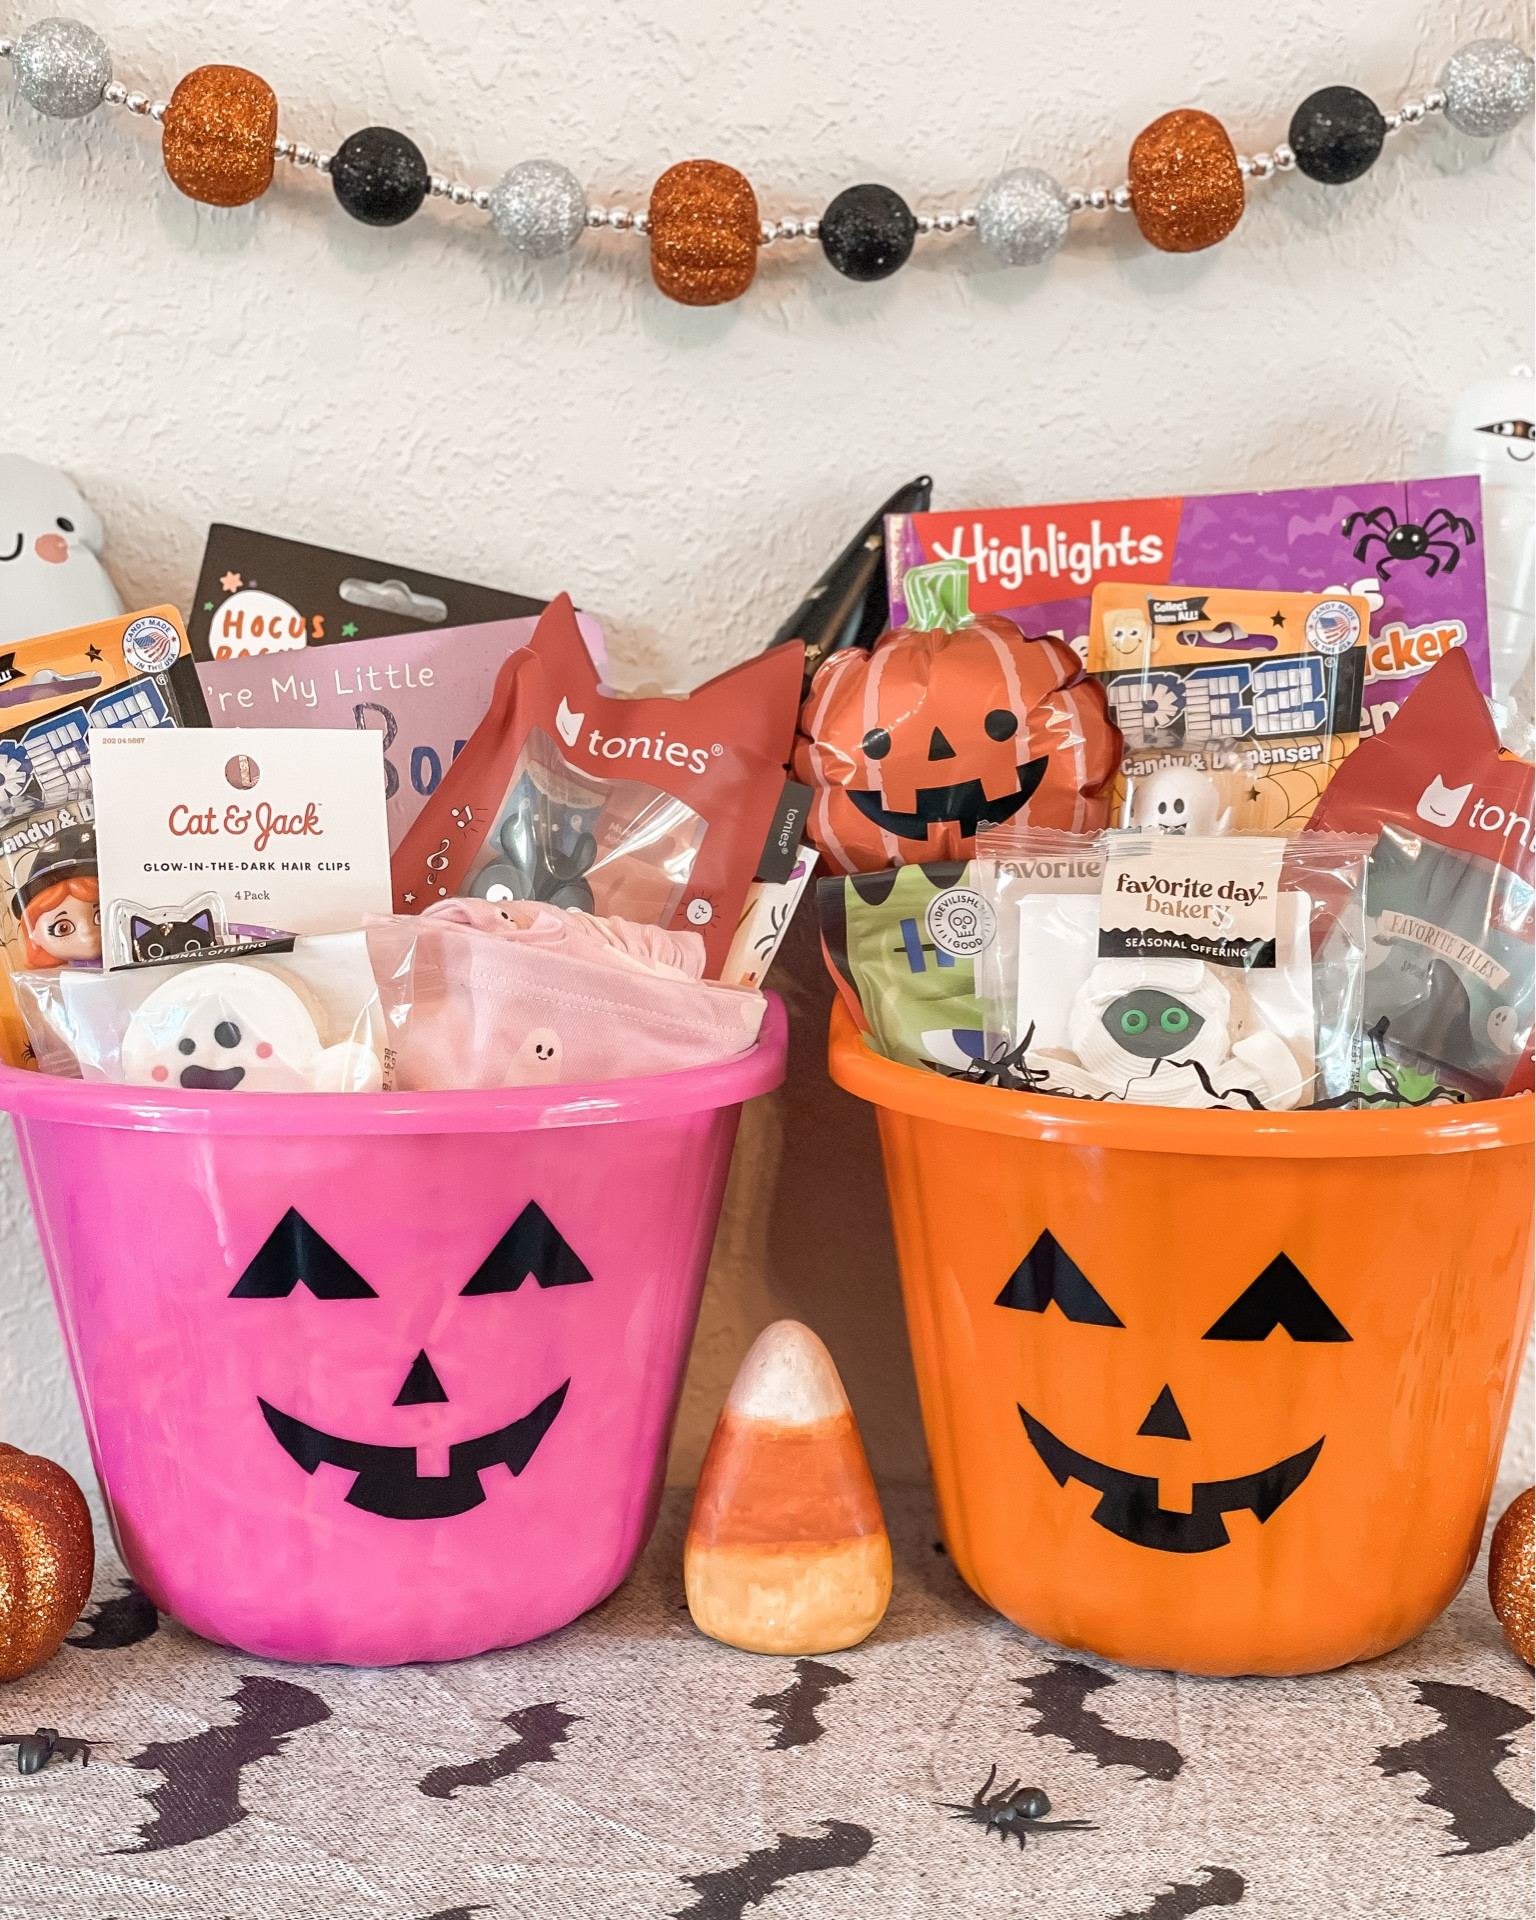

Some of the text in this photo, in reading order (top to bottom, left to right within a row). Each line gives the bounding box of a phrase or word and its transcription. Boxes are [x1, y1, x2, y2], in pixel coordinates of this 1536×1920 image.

[932, 519, 1164, 590] Highlights
[1153, 601, 1188, 612] Collect
[1311, 603, 1357, 621] CANDY MADE
[223, 609, 325, 640] HOCUS
[1154, 610, 1199, 623] them ALL!
[126, 619, 172, 643] CANDY MADE
[1311, 639, 1352, 653] IN THE USA
[135, 661, 145, 669] IN
[164, 653, 177, 666] USA
[271, 675, 318, 707] My
[334, 663, 434, 695] Little
[1189, 754, 1207, 770] &
[58, 808, 77, 829] &
[169, 802, 324, 852] Cat & Jack
[143, 861, 351, 872] GLOW-IN-THE-DARK HAIR CLIPS
[234, 889, 271, 900] 4 Pack
[1115, 872, 1213, 899] favorite
[1145, 894, 1231, 928] bakery
[207, 941, 268, 957] OFFERING
[952, 937, 984, 950] GOOD
[1125, 937, 1249, 958] SEASONAL OFFERING
[1389, 914, 1459, 954] FAVORITE
[1456, 943, 1500, 979] TALES
